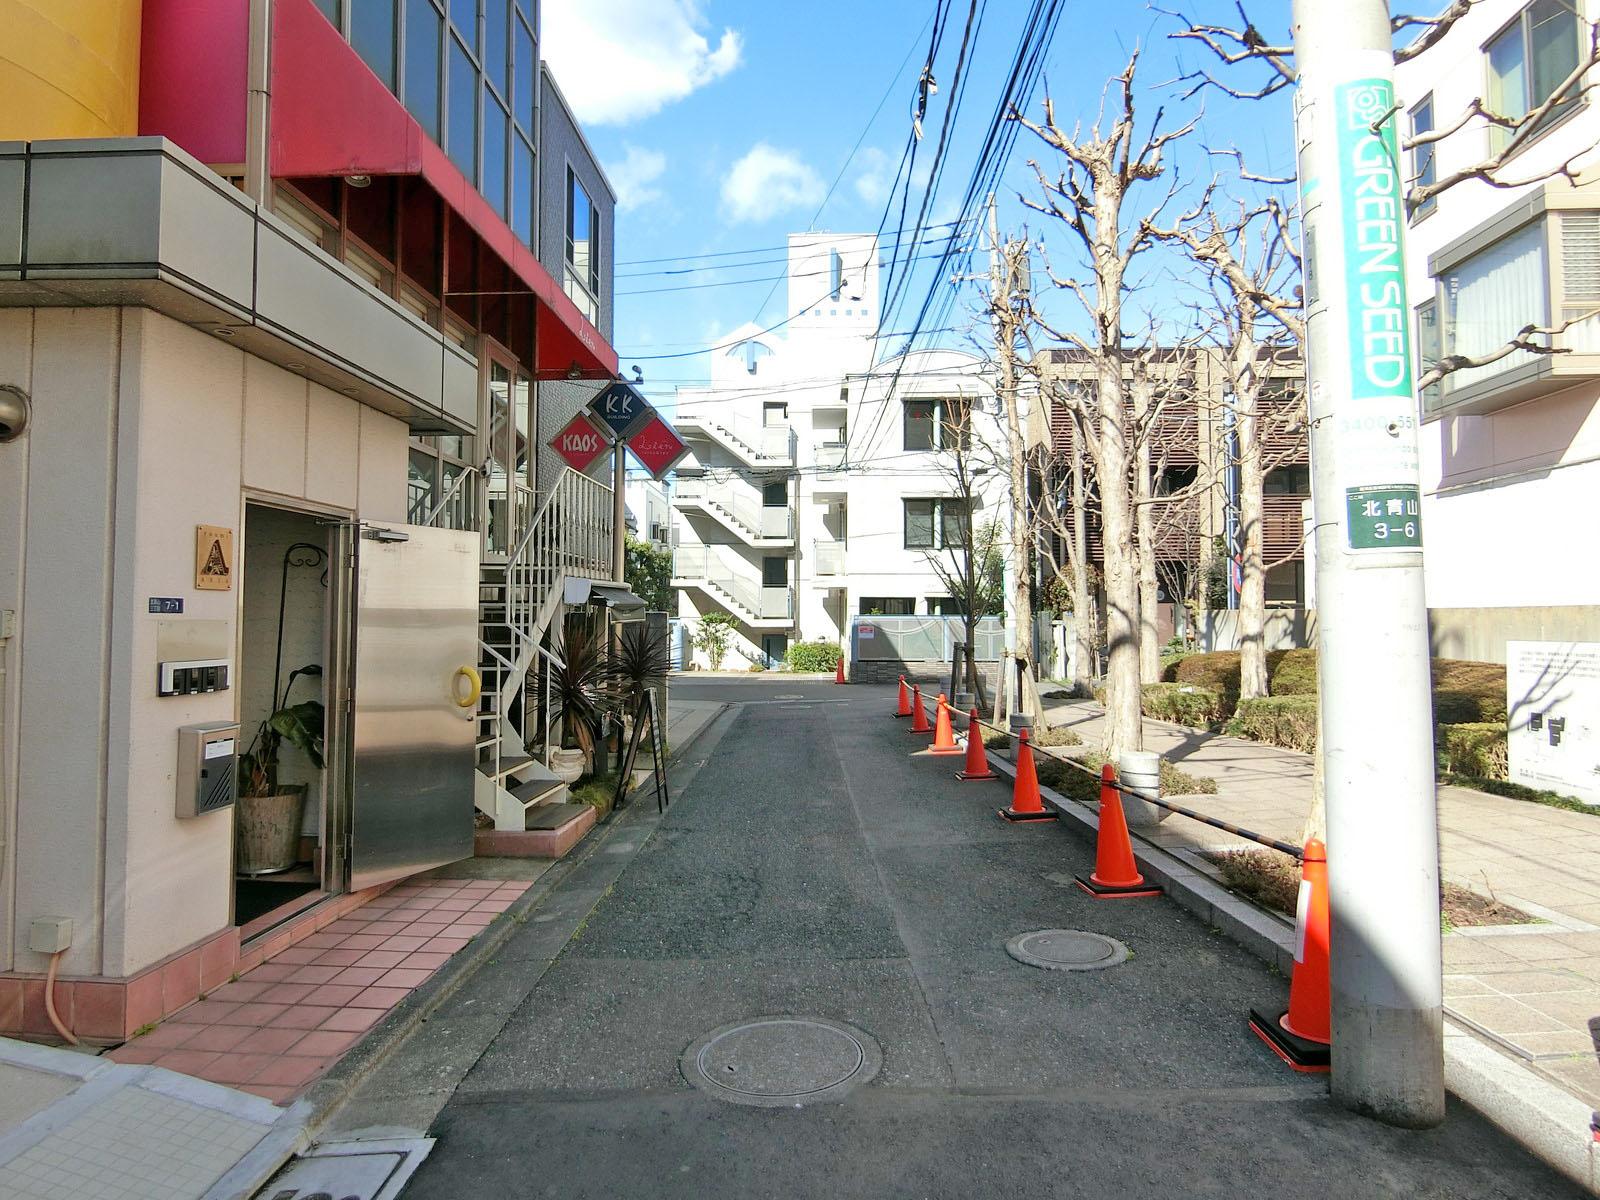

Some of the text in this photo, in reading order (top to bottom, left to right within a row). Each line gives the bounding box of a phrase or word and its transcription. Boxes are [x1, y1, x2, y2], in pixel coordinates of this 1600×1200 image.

[1353, 136, 1405, 388] GREEN SEED
[562, 433, 598, 452] KAOS
[1361, 498, 1418, 517] 北青山
[1373, 521, 1415, 539] 3-6
[165, 601, 179, 611] 7-1
